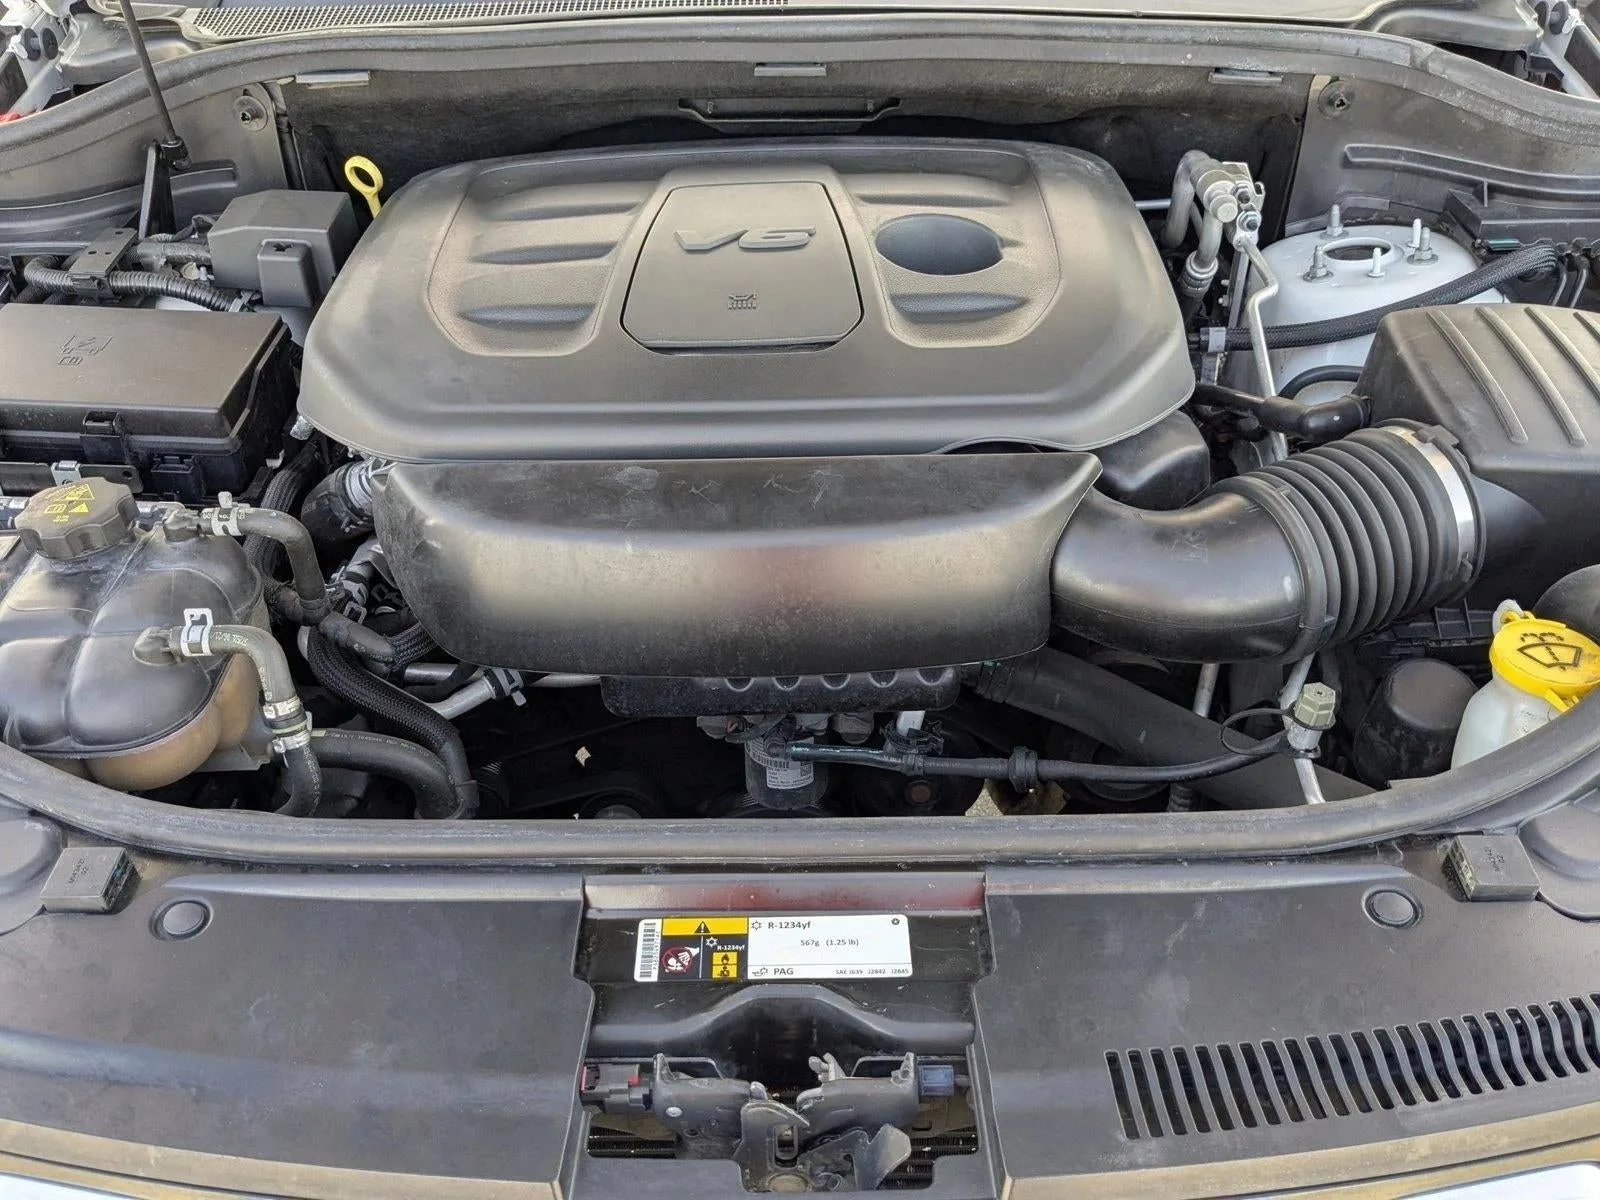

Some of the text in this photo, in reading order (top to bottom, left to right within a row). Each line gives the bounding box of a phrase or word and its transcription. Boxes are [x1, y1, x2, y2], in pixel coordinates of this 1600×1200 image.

[674, 225, 816, 253] V6
[768, 920, 811, 930] R-1234yf
[800, 939, 820, 947] 567g
[848, 938, 859, 946] lb)
[773, 967, 794, 976] PAG
